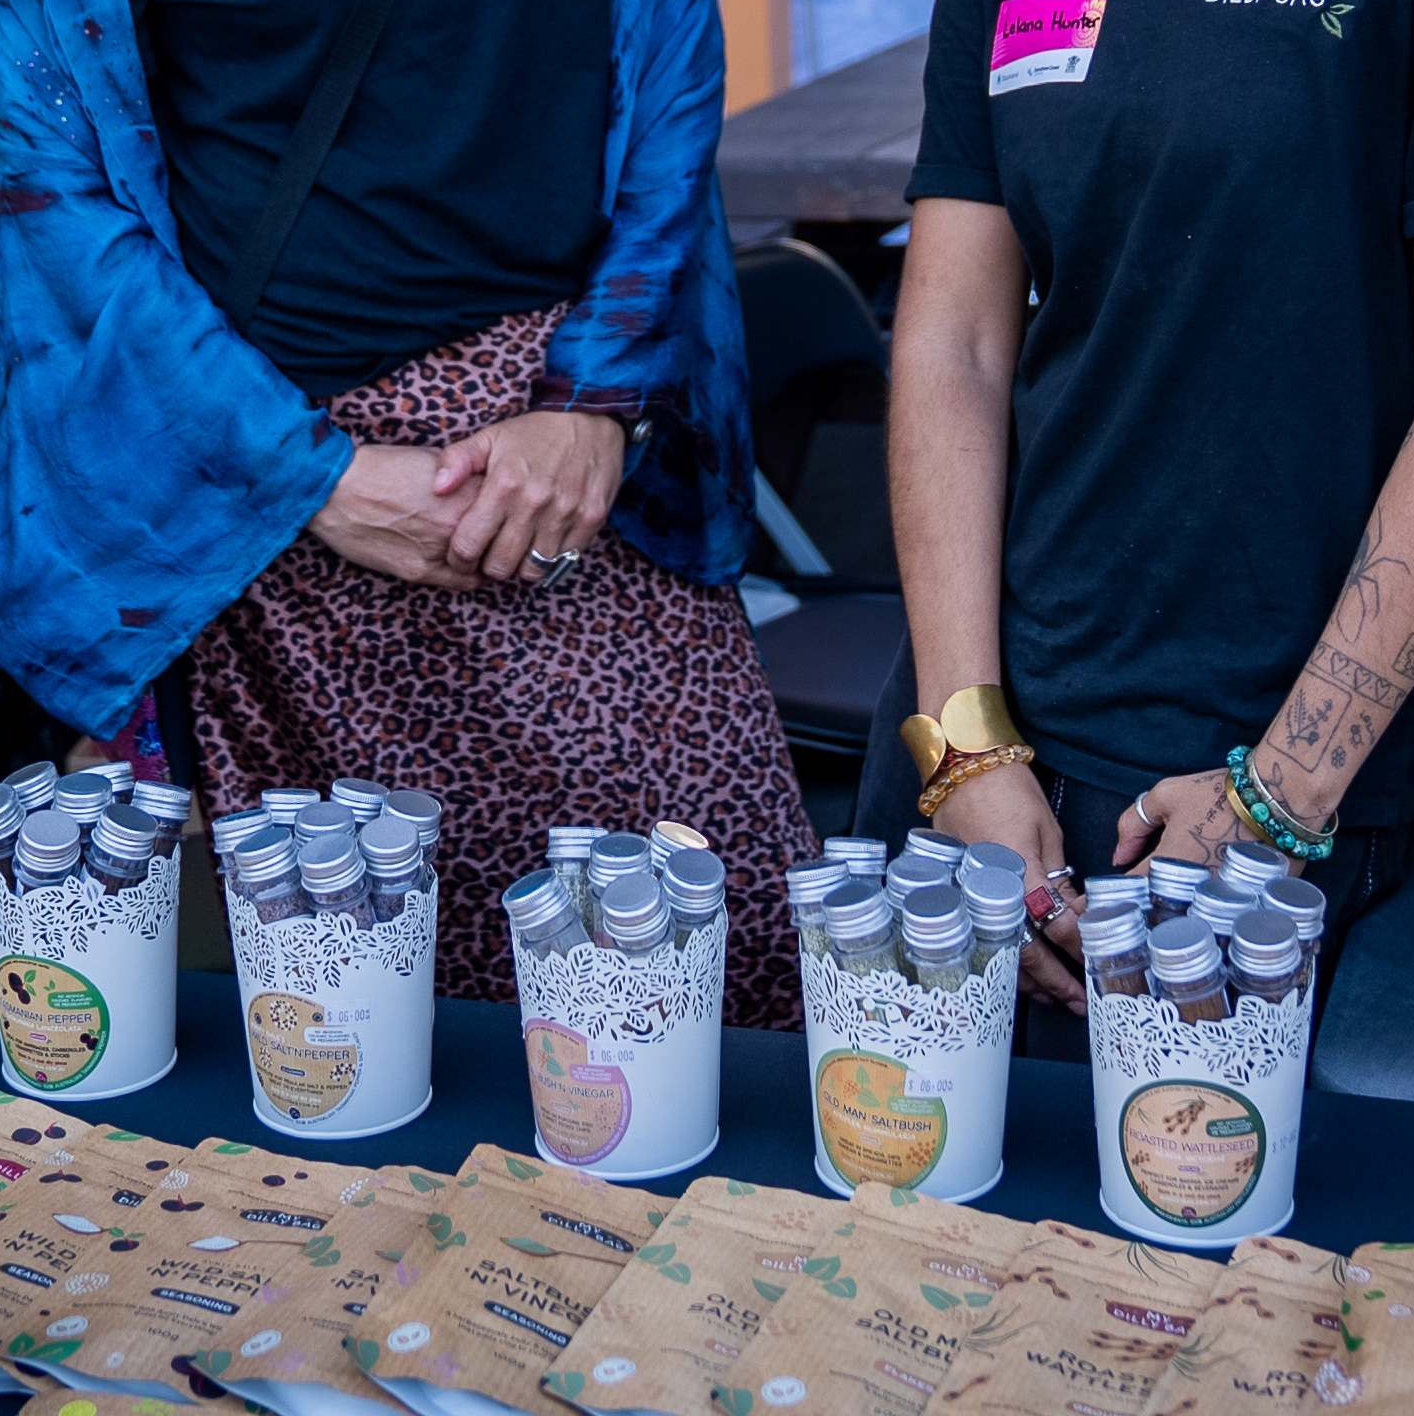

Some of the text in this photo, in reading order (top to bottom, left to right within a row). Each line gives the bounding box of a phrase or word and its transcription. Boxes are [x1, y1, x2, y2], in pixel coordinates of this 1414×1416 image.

[48, 1013, 92, 1024] PEPPER
[569, 1087, 615, 1098] VINEGAR
[844, 1105, 866, 1120] MAN
[872, 1115, 932, 1131] SALTBUSH
[1129, 1128, 1255, 1153] ROASTED WATTLESEED
[18, 1230, 77, 1261] WILD
[160, 1258, 222, 1275] WILD
[159, 1290, 233, 1313] SEASONING
[479, 1260, 593, 1316] SALTBUS
[505, 1284, 585, 1326] VINEG
[707, 1293, 760, 1322] OLD
[493, 1304, 567, 1344] SEASONING
[874, 1308, 929, 1338] OLD
[1027, 1350, 1151, 1398] WATTLES
[1058, 1349, 1156, 1385] ROAST
